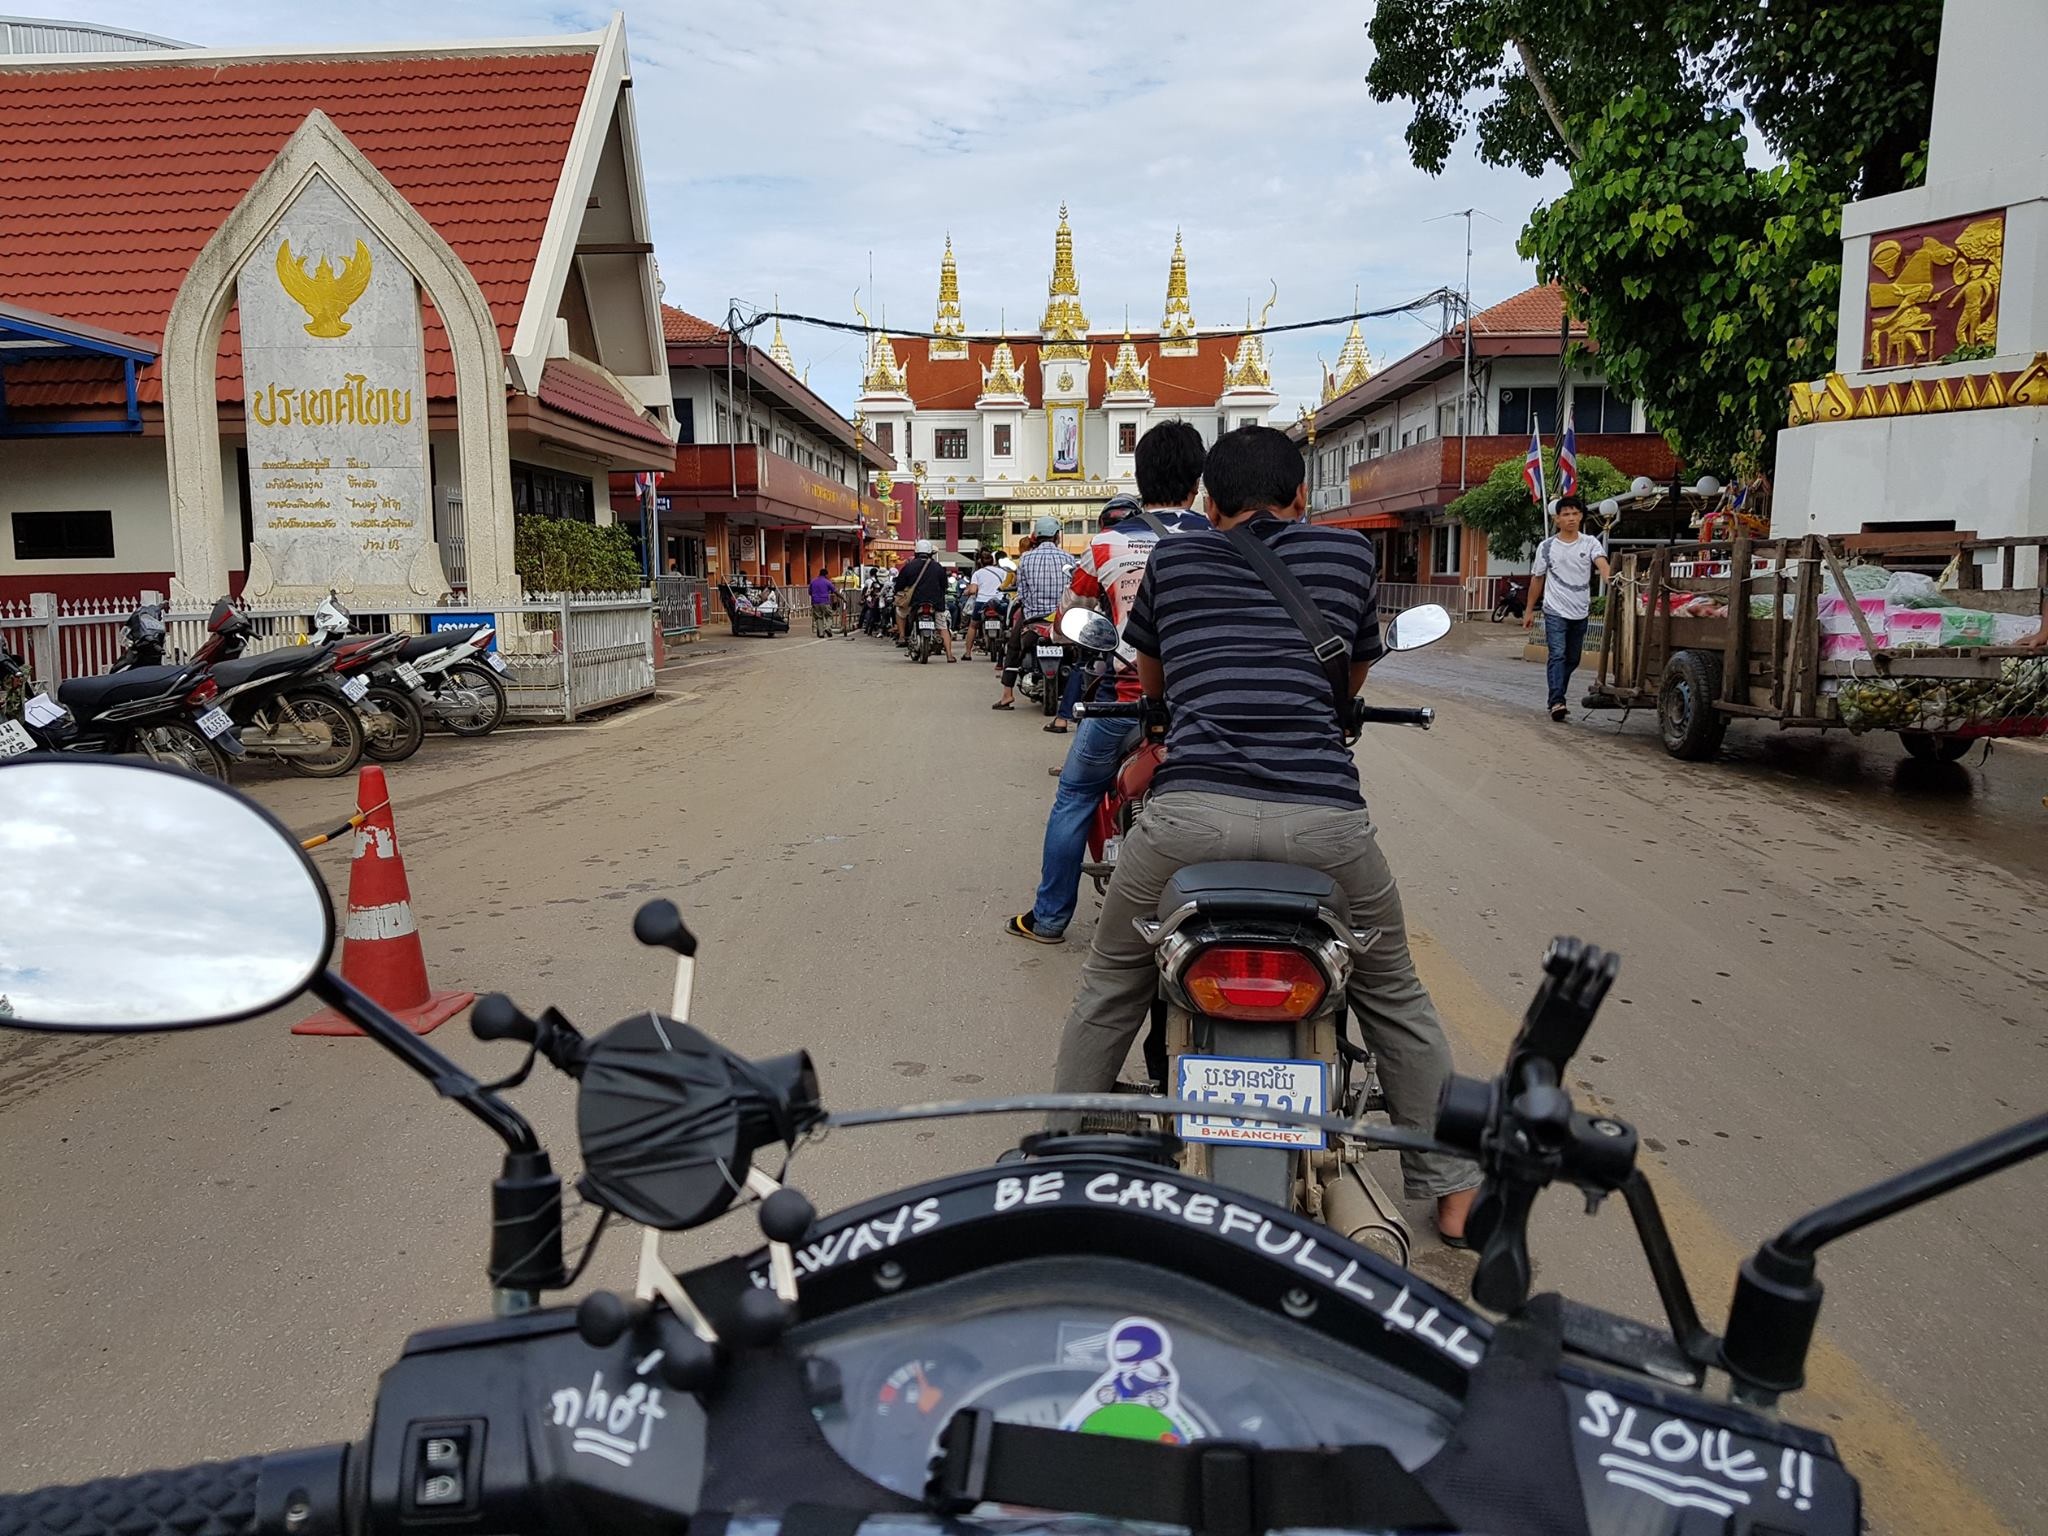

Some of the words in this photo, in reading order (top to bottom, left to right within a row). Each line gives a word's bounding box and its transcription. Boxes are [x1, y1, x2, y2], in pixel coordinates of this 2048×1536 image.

[253, 372, 412, 427] ประเทศไทย
[1012, 486, 1056, 497] KINGDOM
[1057, 486, 1071, 497] OF
[1072, 485, 1119, 497] THAILAND
[1201, 1127, 1303, 1143] B-MEANCHEY
[750, 1197, 940, 1290] WAYS
[994, 1171, 1065, 1211] BE
